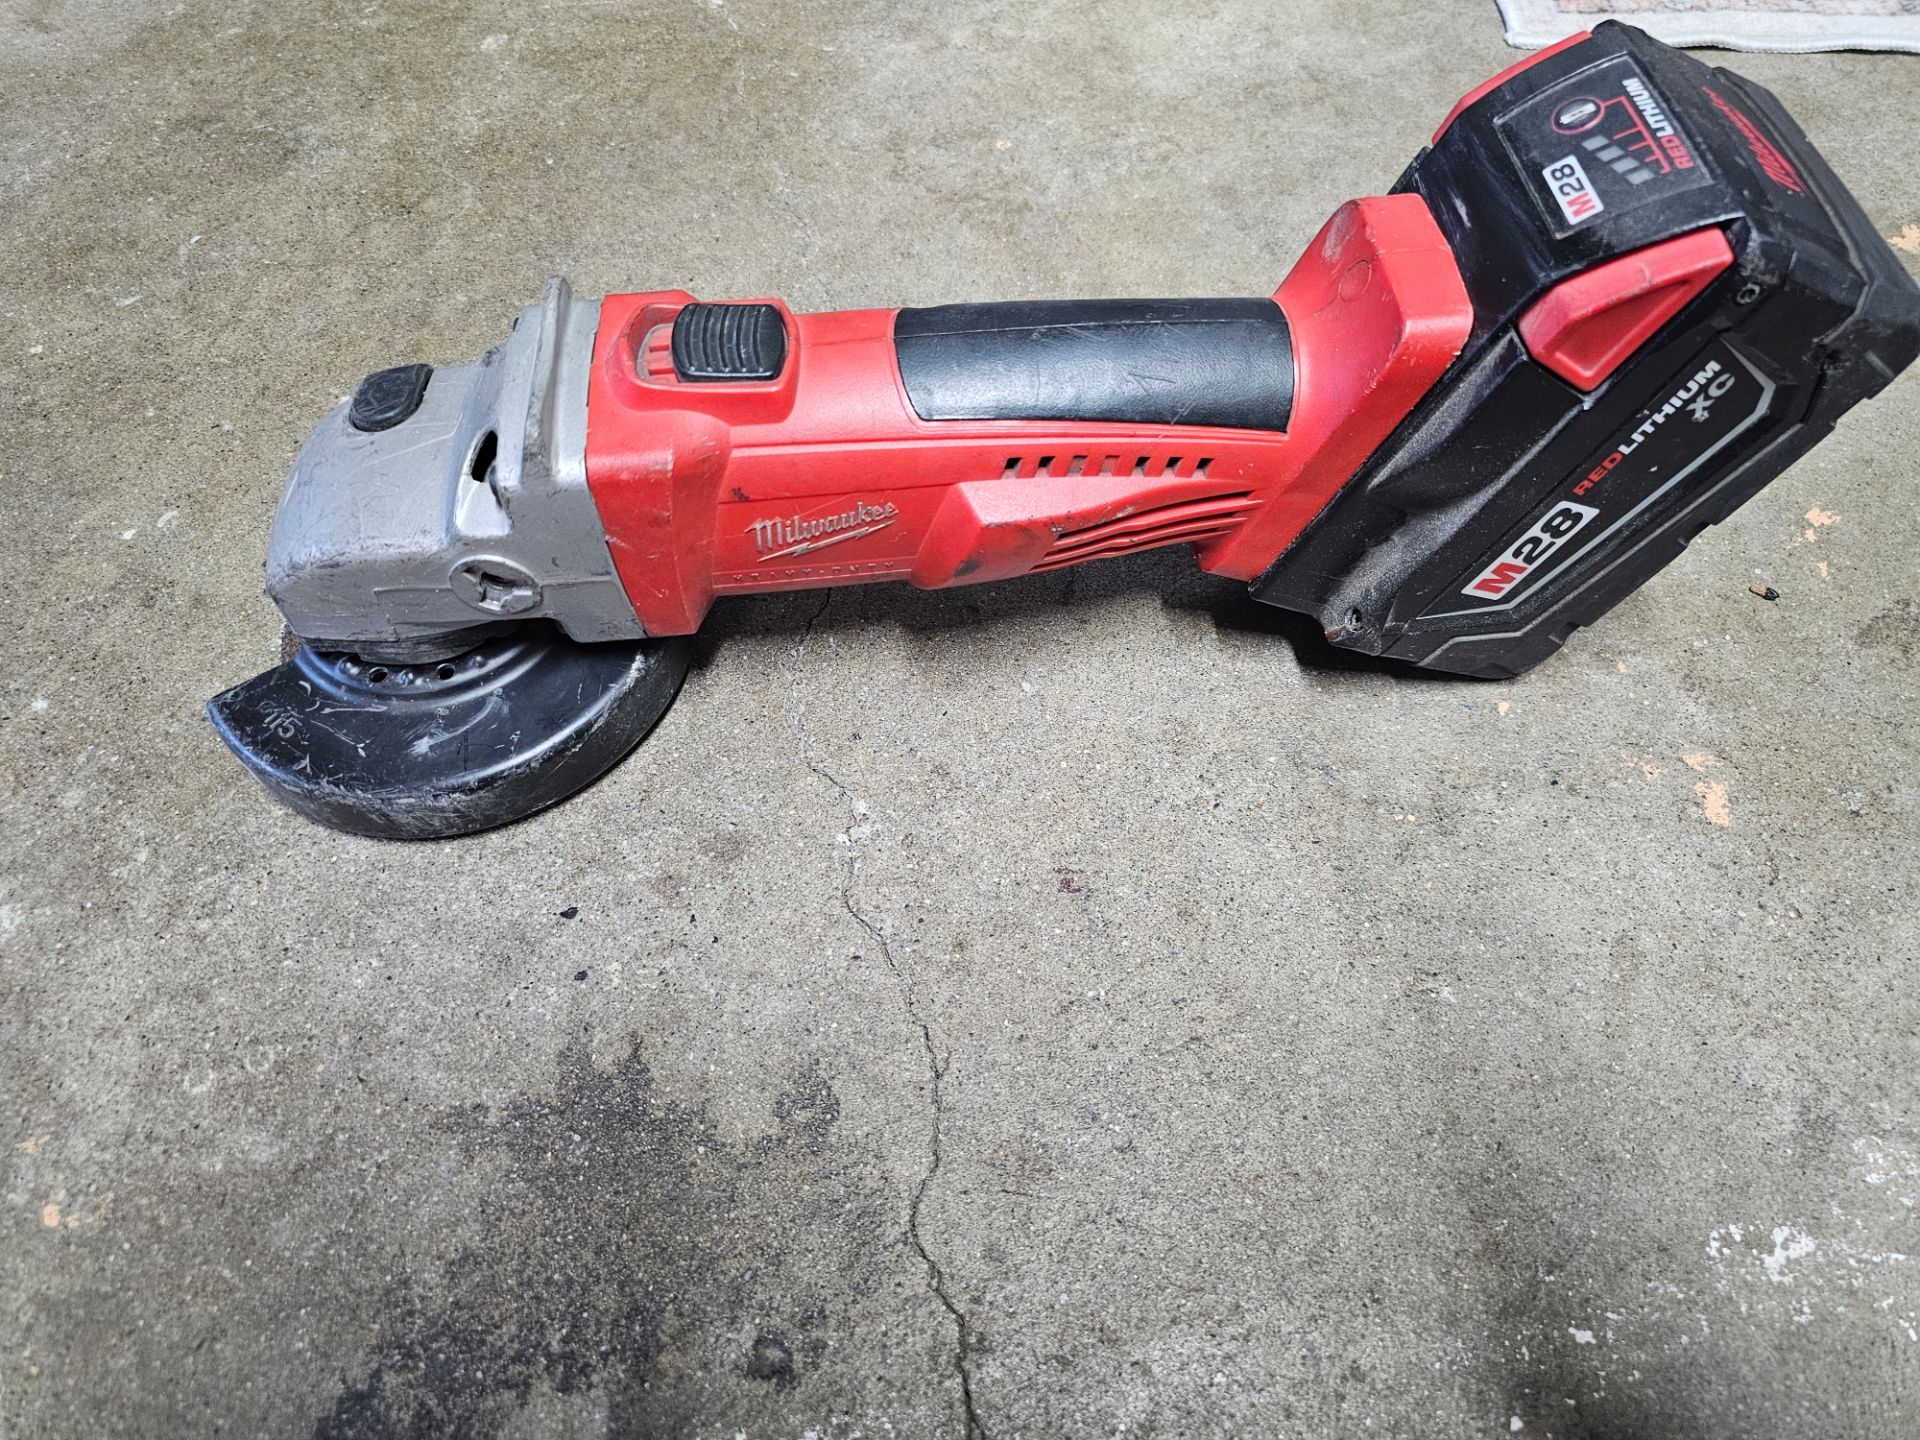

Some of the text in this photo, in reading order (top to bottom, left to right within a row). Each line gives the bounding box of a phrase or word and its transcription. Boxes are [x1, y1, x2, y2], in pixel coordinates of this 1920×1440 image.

[1621, 77, 1695, 170] REDLITHIUM
[1550, 162, 1597, 219] M28
[1572, 359, 1722, 496] REDLITHIUM
[1685, 373, 1736, 422] XC
[744, 501, 900, 551] Milwaukee
[1473, 507, 1584, 594] M28
